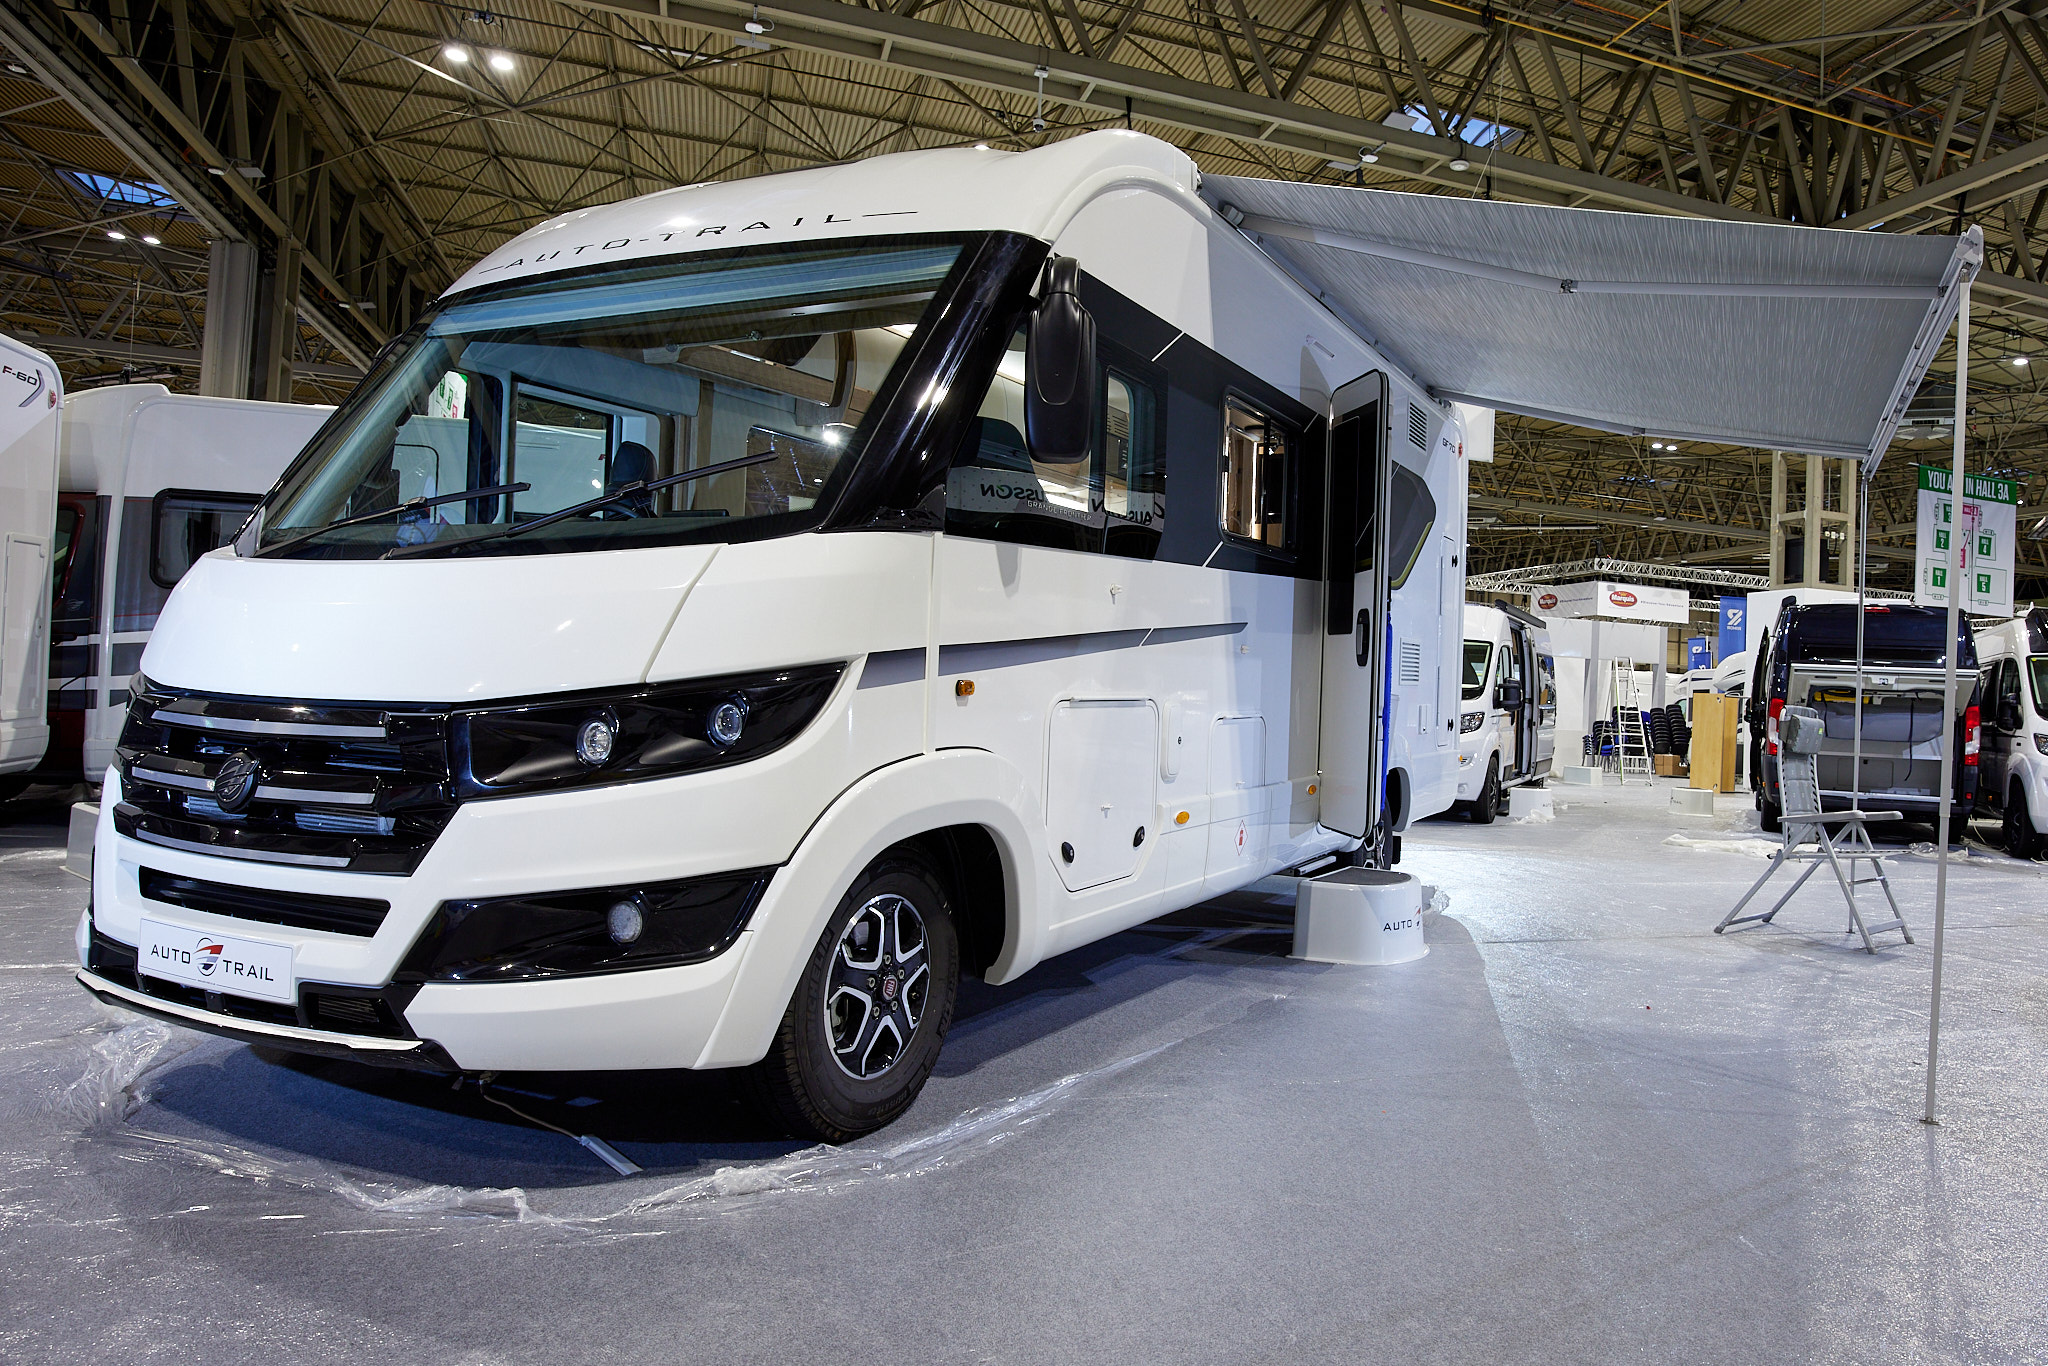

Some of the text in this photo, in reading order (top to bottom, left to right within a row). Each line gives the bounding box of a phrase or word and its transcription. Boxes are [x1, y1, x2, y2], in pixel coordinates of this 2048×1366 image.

[505, 214, 851, 268] AUTO-TRAIL
[2, 365, 37, 386] F-60
[1927, 470, 1946, 490] YOU
[1965, 477, 1974, 495] IN
[1975, 479, 1996, 499] HALL
[1997, 483, 2009, 501] 3A
[1940, 538, 1945, 548] 2
[1982, 544, 1987, 554] 4
[1937, 576, 1941, 586] 1
[1981, 582, 1986, 592] 5
[1611, 594, 1635, 603] Marquis
[1383, 919, 1412, 931] AUTO
[151, 944, 274, 982] AUTO TRAIL
